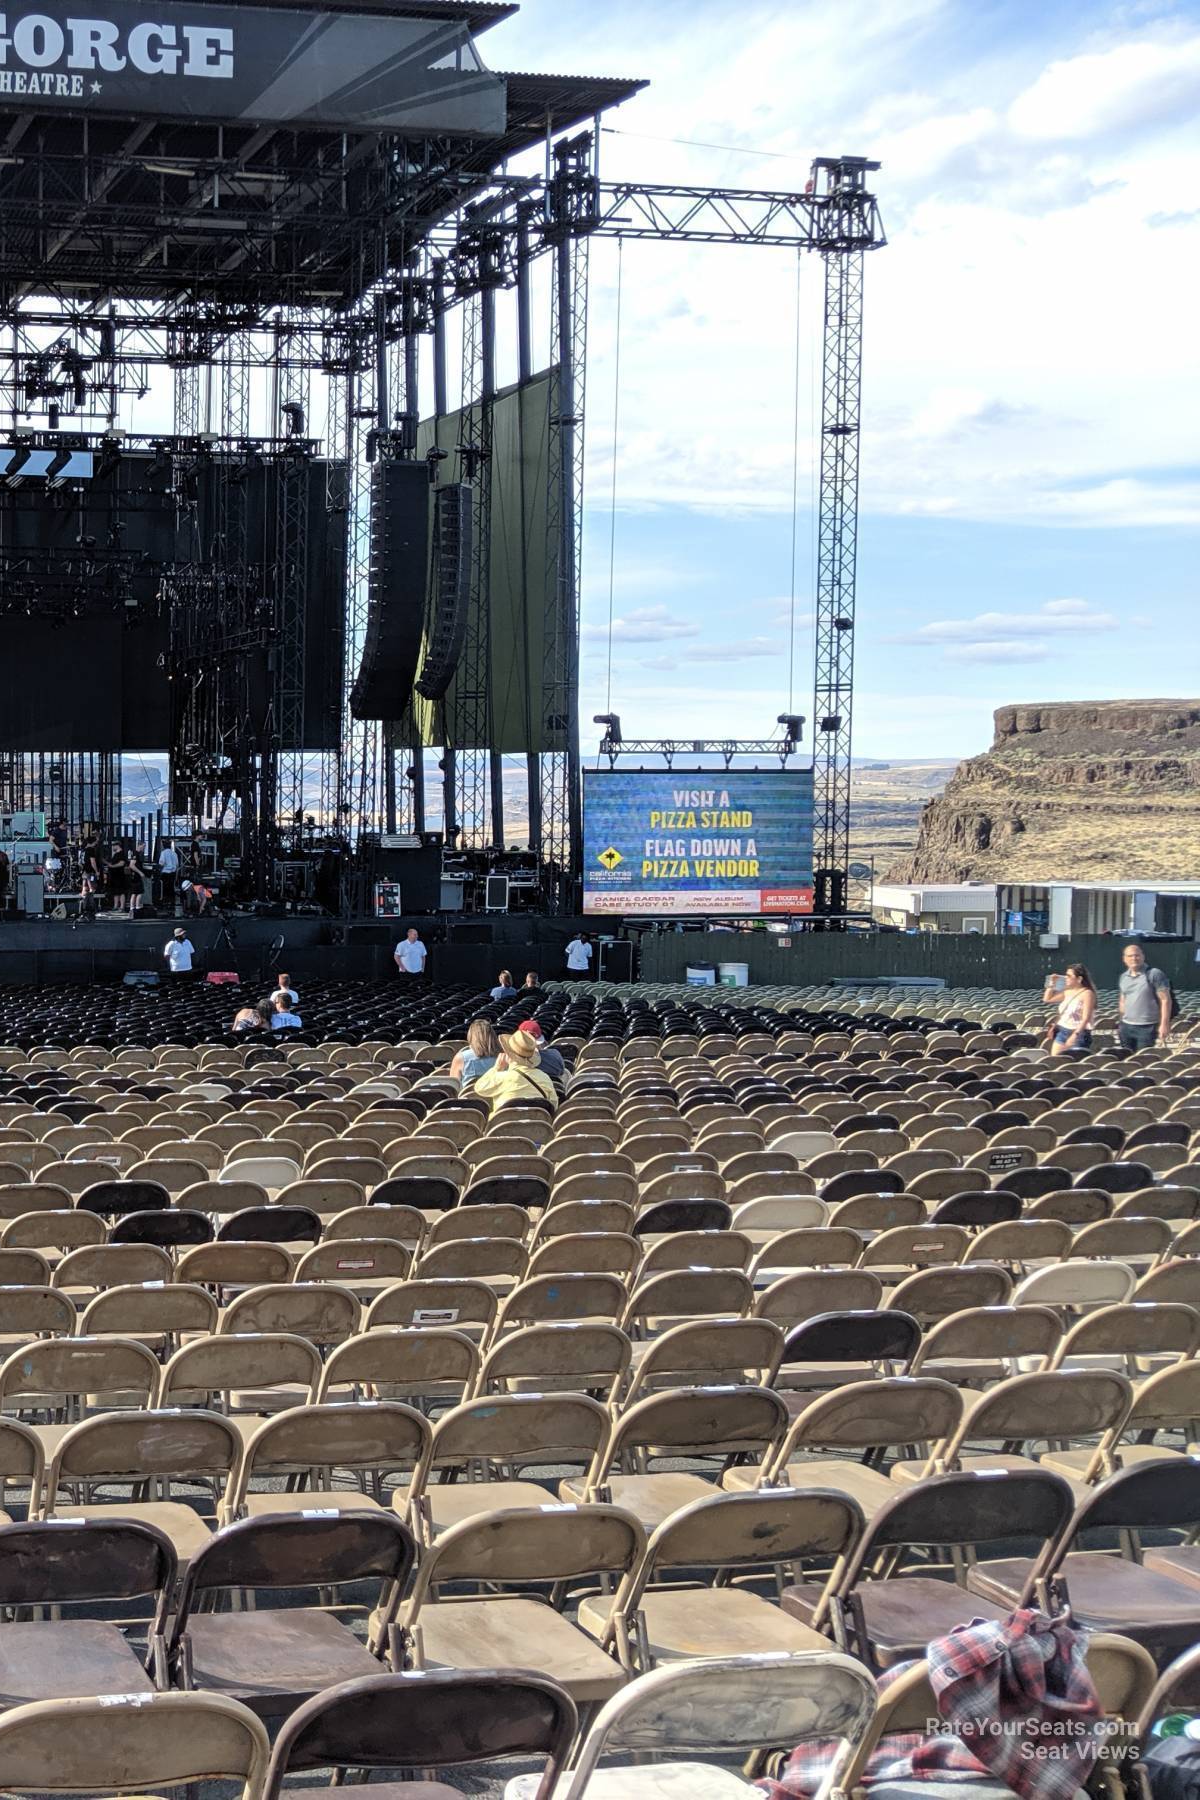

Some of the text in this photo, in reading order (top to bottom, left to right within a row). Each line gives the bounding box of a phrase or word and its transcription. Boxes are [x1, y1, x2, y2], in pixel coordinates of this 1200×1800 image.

[673, 790, 730, 807] VISIT A
[650, 811, 753, 828] PIZZA STAND
[645, 839, 757, 857] FLAG DOWN A
[642, 859, 760, 878] PIZZA VENDOR
